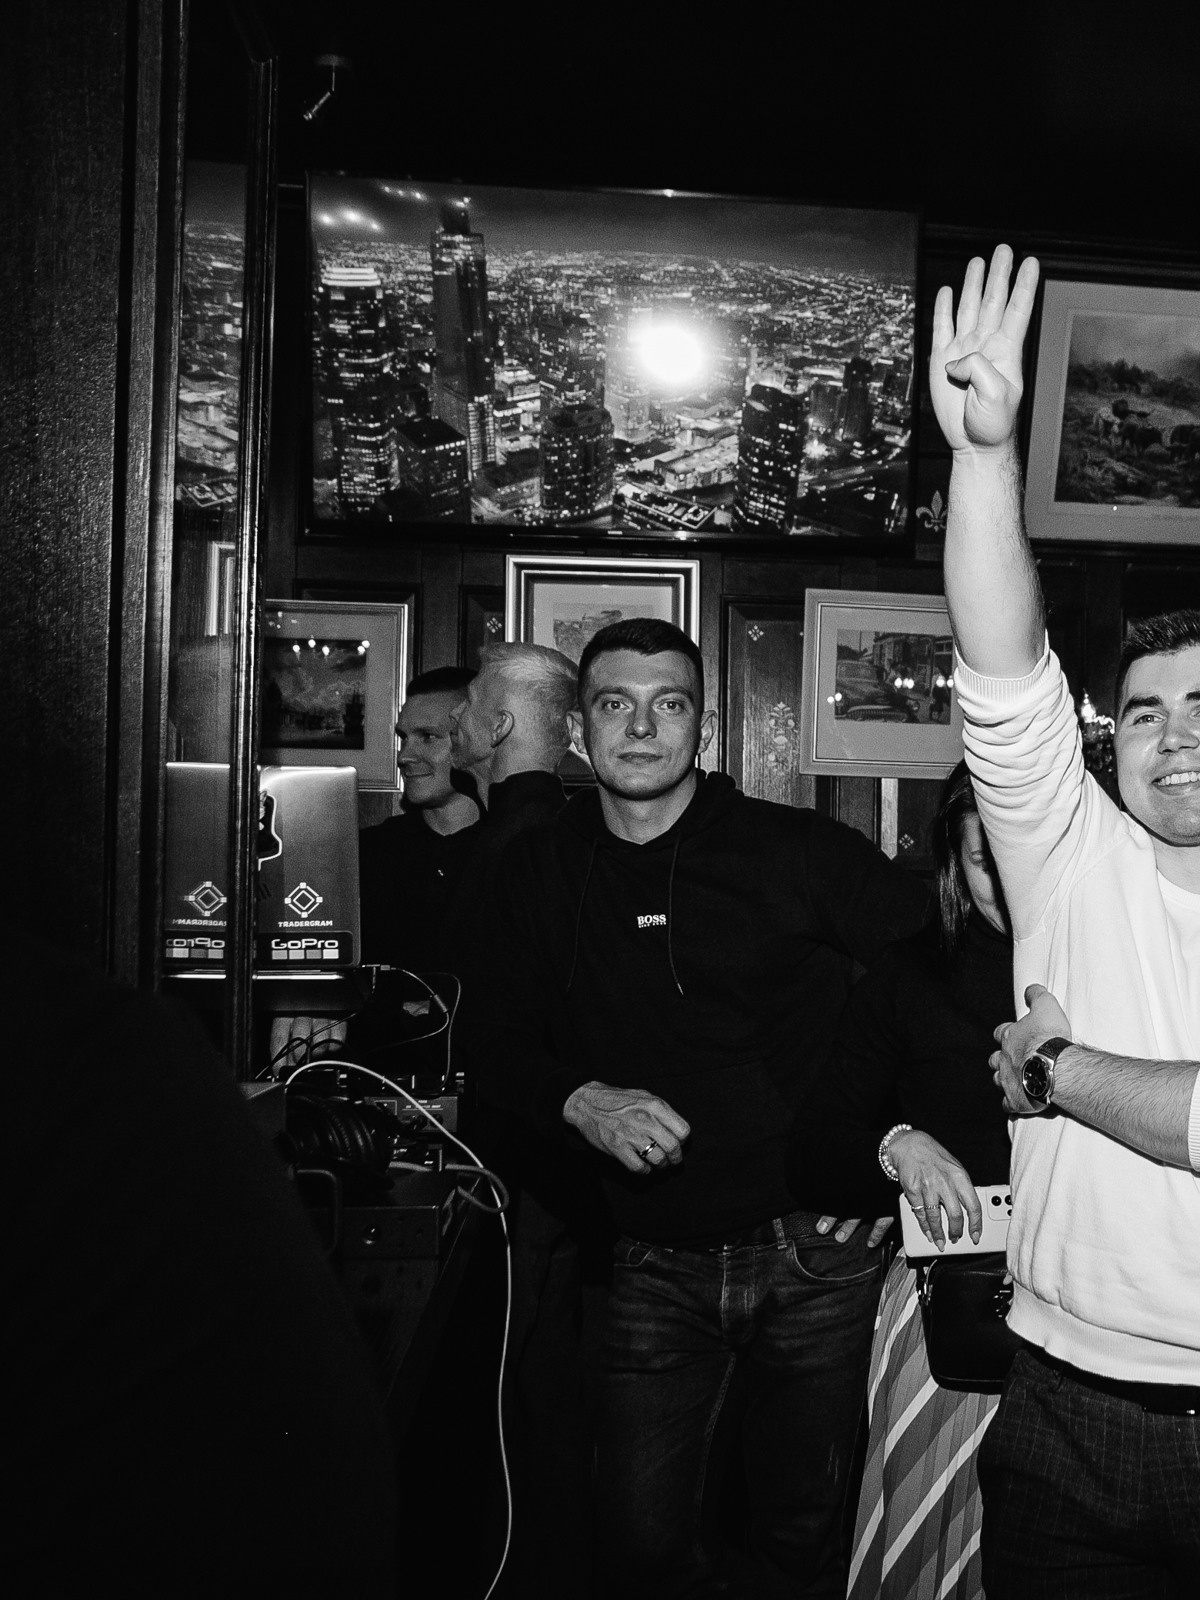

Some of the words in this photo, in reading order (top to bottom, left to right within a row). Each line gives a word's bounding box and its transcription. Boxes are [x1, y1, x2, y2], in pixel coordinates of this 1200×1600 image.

[278, 920, 333, 928] TRADERGRAM
[637, 914, 667, 925] BOSS
[271, 938, 339, 949] GoPro
